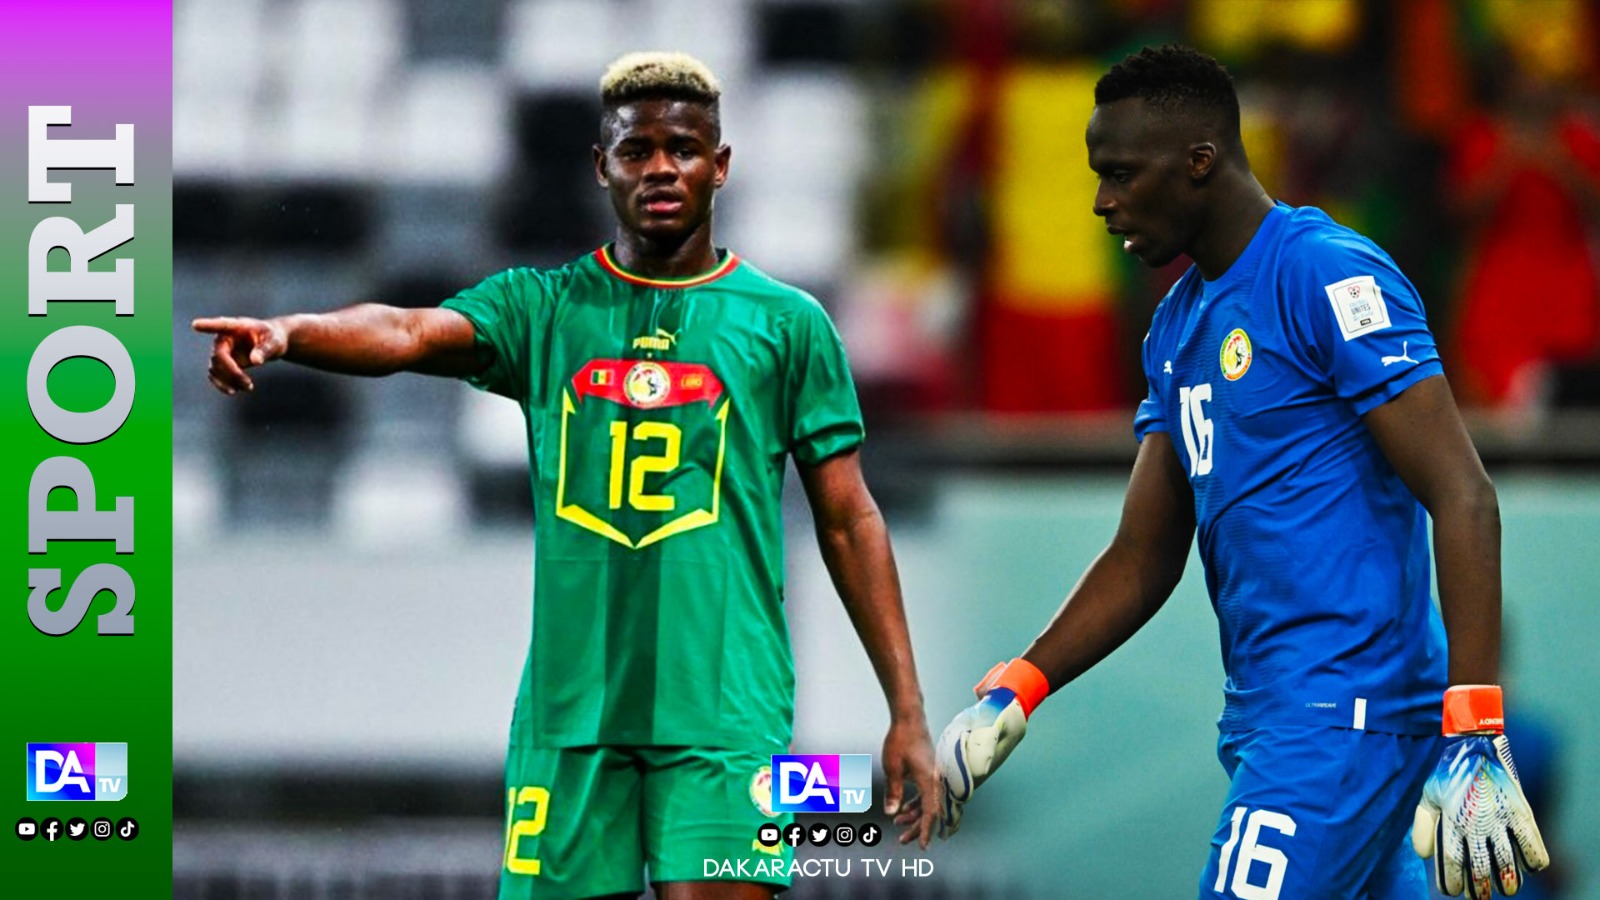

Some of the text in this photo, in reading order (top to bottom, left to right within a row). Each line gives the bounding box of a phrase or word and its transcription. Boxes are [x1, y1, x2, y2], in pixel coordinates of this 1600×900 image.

[609, 421, 681, 511] 12
[1179, 383, 1214, 477] 16
[1214, 807, 1297, 900] 16
